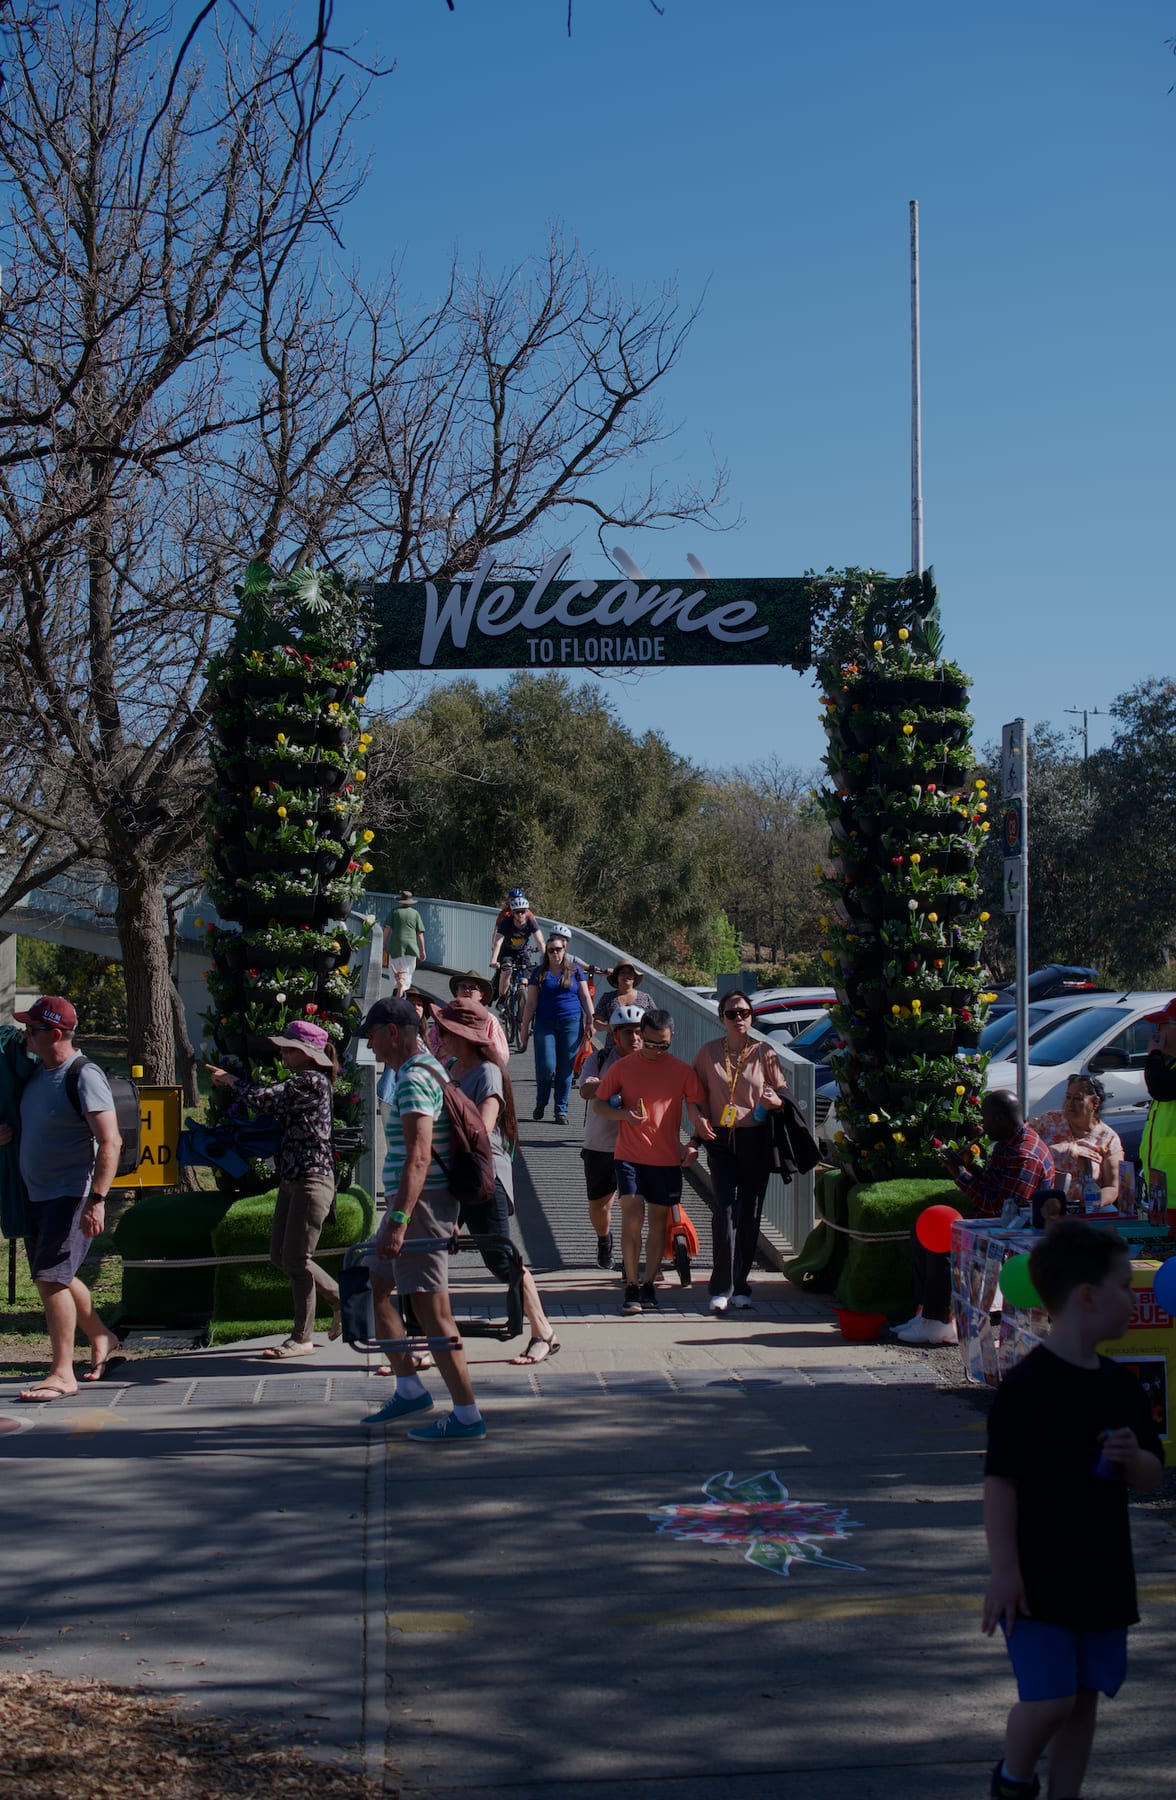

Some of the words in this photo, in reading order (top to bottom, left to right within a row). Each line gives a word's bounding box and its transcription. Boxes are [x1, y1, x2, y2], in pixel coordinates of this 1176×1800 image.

[419, 547, 769, 666] Welcome
[527, 638, 555, 663] TO
[560, 636, 666, 663] FLORIADE
[139, 1110, 151, 1130] H
[139, 1145, 171, 1165] AD
[1140, 1293, 1155, 1304] BI
[1128, 1305, 1167, 1324] SUE
